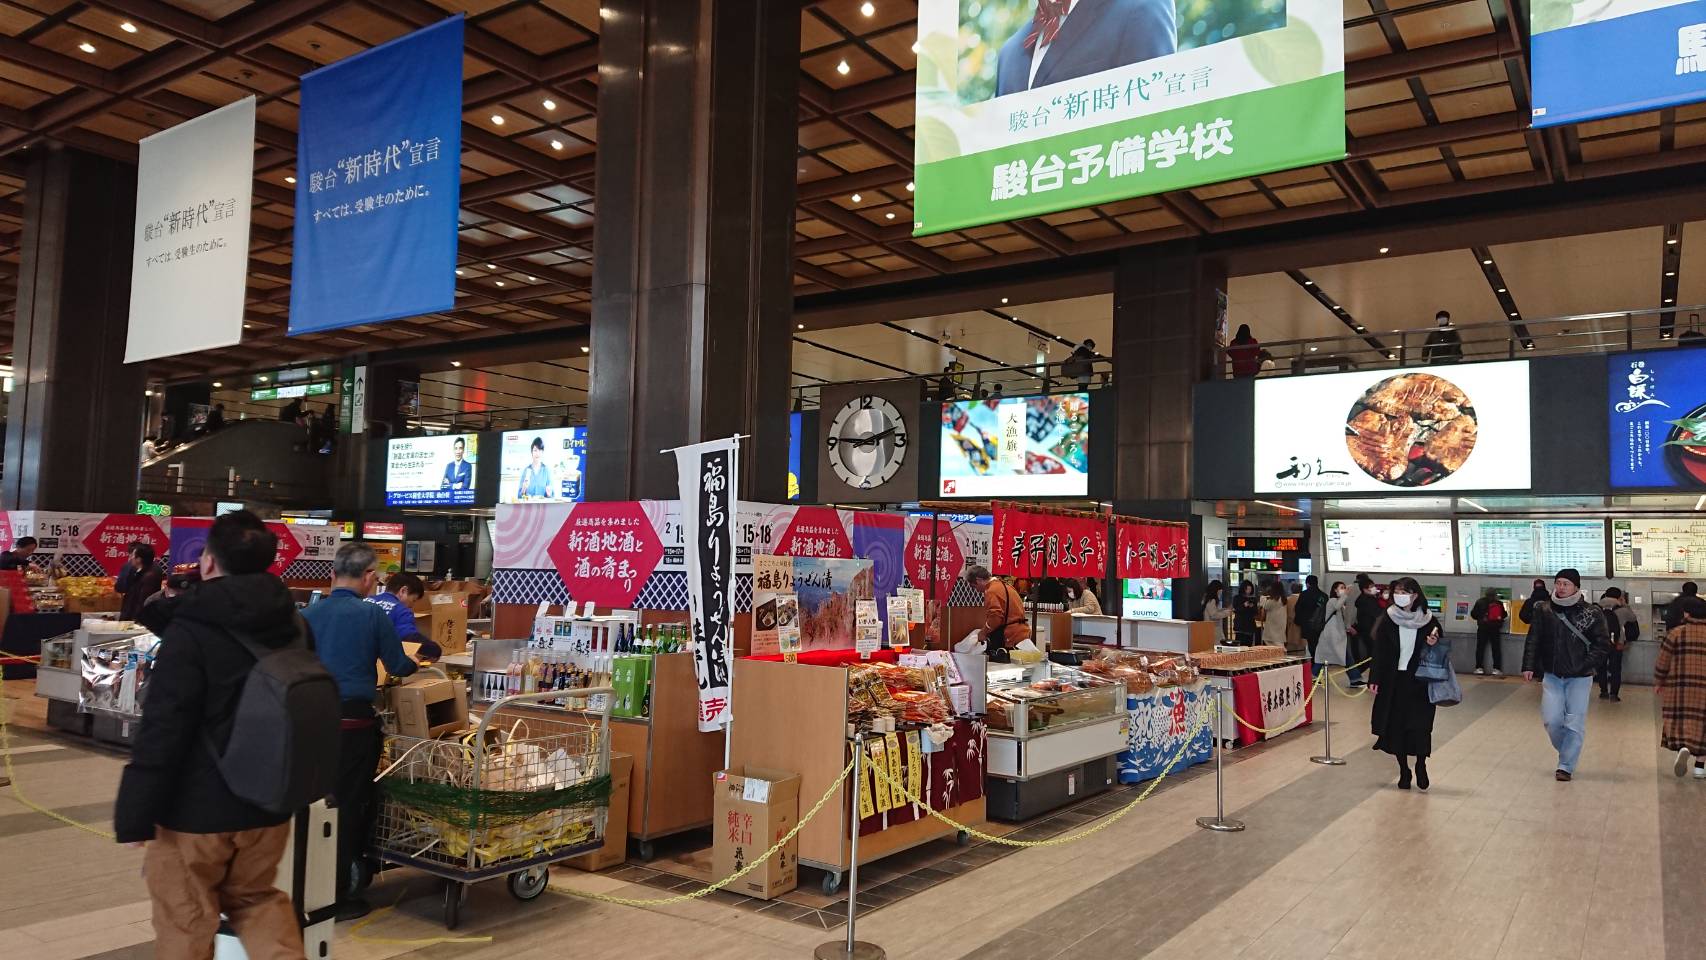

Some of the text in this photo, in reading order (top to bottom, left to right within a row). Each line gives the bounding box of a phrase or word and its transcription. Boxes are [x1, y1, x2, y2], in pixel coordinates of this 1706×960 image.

[991, 118, 1234, 201] 駿台予備学校
[313, 185, 430, 224] すべては、受験生のために。
[860, 396, 875, 409] 12
[827, 437, 838, 450] 9
[894, 433, 906, 447] 3
[137, 500, 172, 516] Days
[666, 522, 671, 533] 2
[568, 530, 643, 553] 新酒地酒と
[790, 536, 842, 557] 新酒地酒と
[757, 569, 832, 590] 福島りょうぜん漬
[728, 810, 740, 843] 純米
